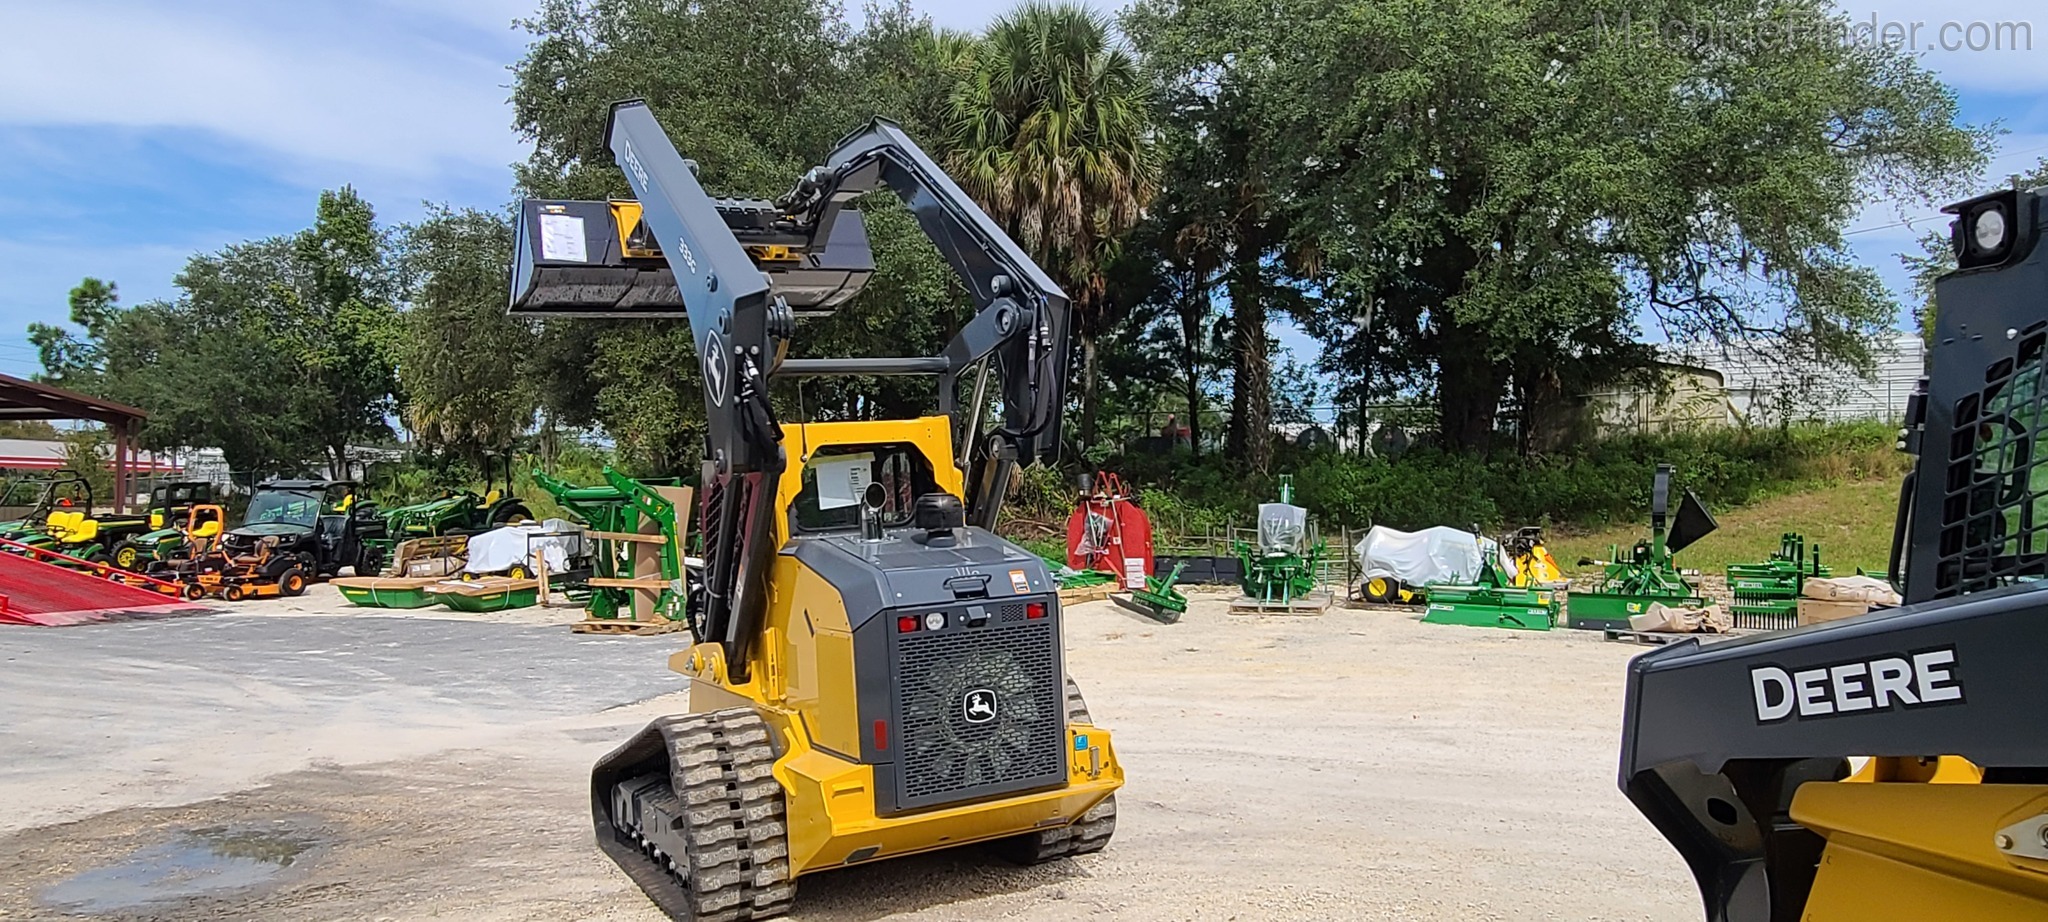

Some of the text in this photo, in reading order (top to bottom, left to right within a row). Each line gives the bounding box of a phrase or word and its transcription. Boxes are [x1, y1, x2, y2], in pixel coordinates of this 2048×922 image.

[625, 140, 648, 192] DEERE
[678, 237, 697, 274] 333G
[1750, 649, 1962, 721] DEERE
